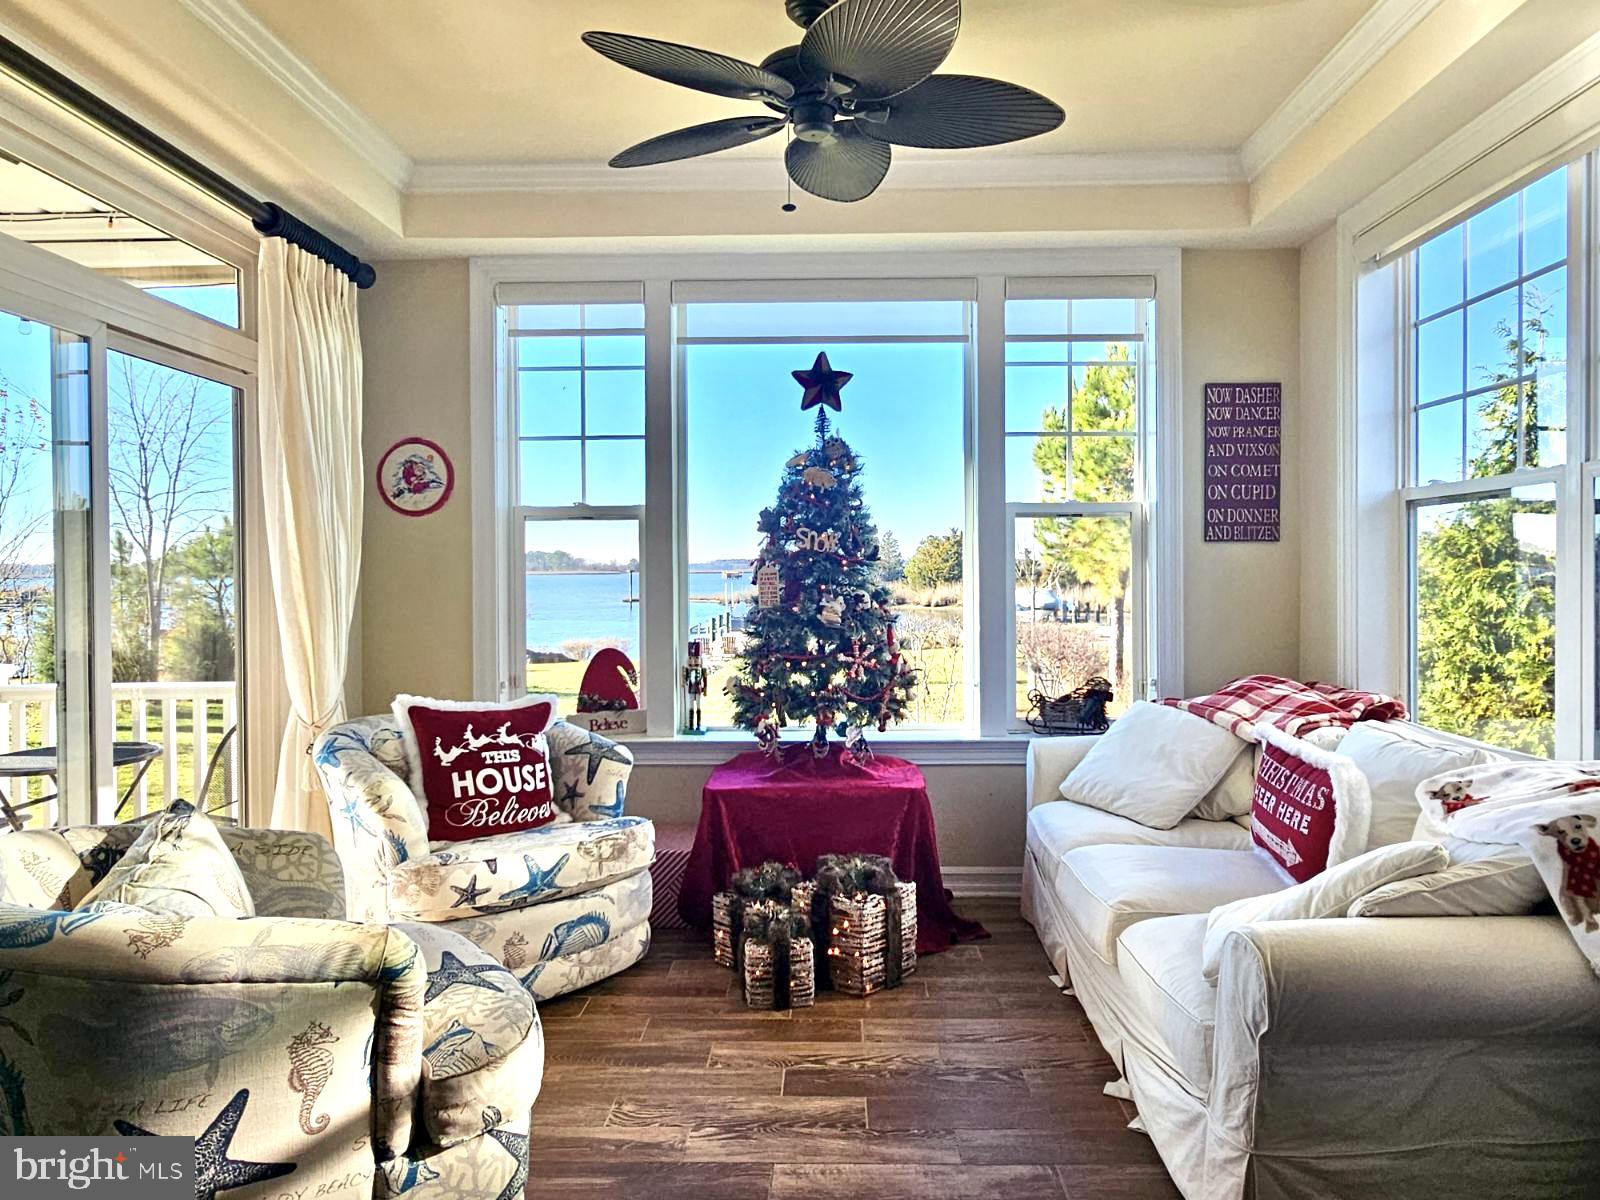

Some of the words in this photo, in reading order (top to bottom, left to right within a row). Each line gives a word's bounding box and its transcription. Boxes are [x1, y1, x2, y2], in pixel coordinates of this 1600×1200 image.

[1207, 388, 1232, 403] NOW
[1235, 387, 1280, 403] DASHER
[1207, 407, 1232, 421] NOW
[1235, 406, 1280, 420] DANCER
[1207, 426, 1230, 438] NOW
[1232, 426, 1280, 438] PRANCER
[1208, 444, 1234, 457] AND
[1208, 464, 1228, 477] ON
[1230, 464, 1280, 477] COMET
[1208, 484, 1228, 500] ON
[1230, 484, 1276, 500] CUPID
[1207, 508, 1225, 523] ON
[1227, 508, 1279, 523] DONNER
[1206, 526, 1232, 540] AND
[1233, 525, 1280, 540] BLITZEN
[589, 718, 629, 732] Believe
[481, 750, 521, 764] THIS
[451, 763, 546, 798] HOUSE
[1254, 784, 1277, 814] HEER
[1276, 801, 1311, 834] HERE
